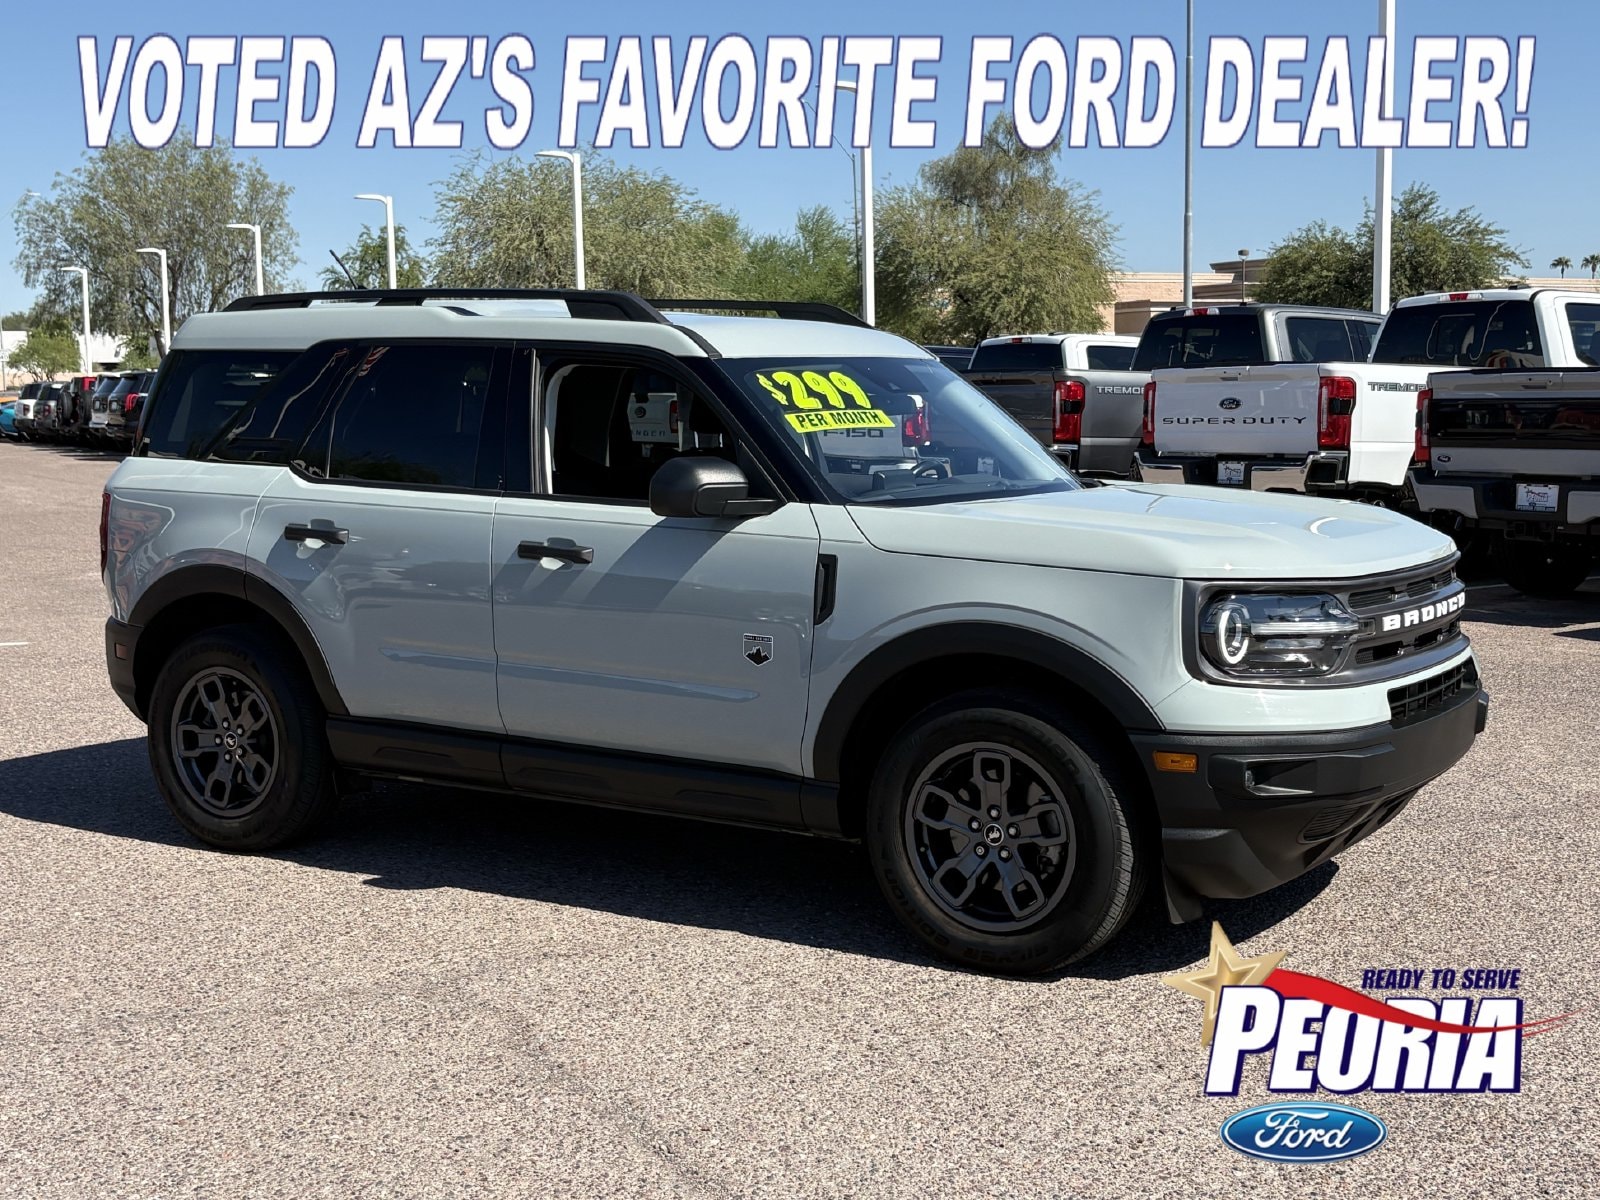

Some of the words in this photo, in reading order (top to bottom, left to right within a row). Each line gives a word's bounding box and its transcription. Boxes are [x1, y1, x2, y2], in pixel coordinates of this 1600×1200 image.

[756, 371, 872, 410] $299
[1368, 382, 1427, 393] TREMOR
[795, 413, 828, 429] PER
[832, 409, 883, 426] MONTH
[1162, 416, 1236, 425] SUPER
[1243, 416, 1307, 425] DUTY
[823, 428, 884, 438] F-150
[1381, 591, 1465, 632] BRONCO
